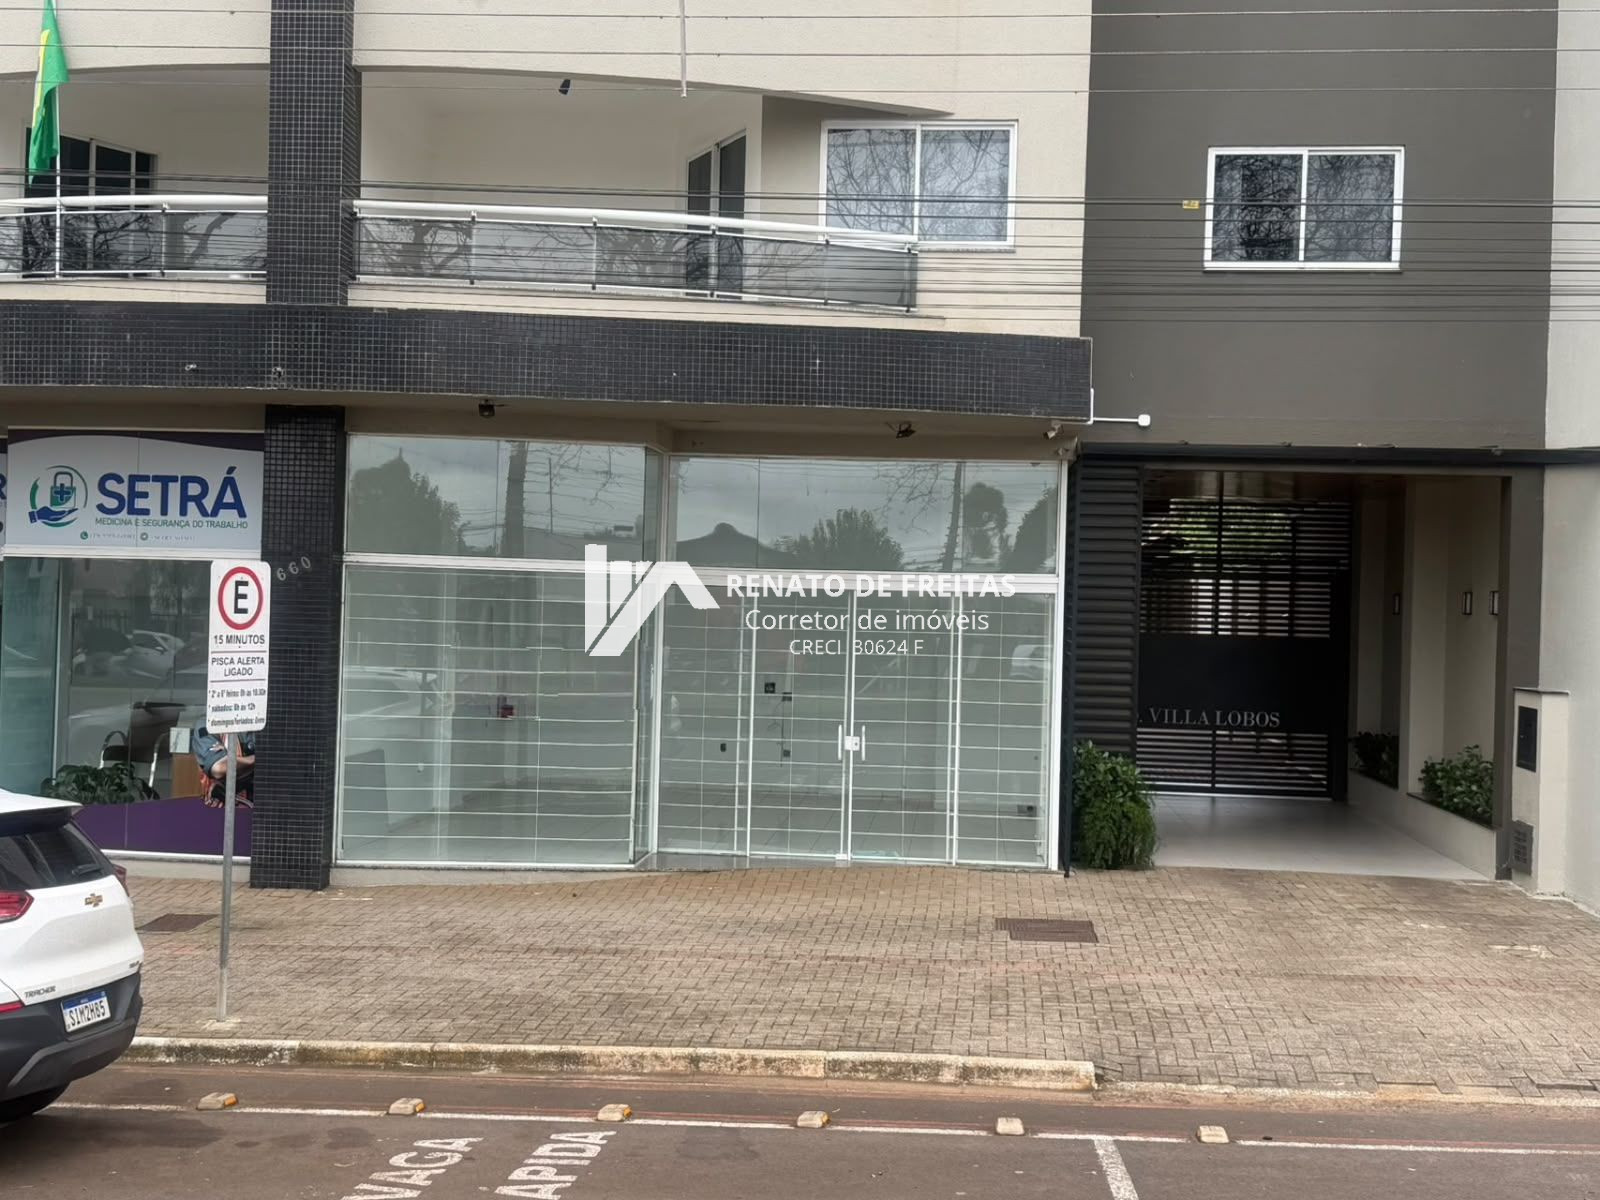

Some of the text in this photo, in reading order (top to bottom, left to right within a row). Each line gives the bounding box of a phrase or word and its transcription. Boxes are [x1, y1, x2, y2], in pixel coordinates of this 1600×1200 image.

[96, 466, 247, 518] SETRÁ
[95, 517, 133, 526] MEDICINA
[142, 518, 190, 529] SEGURANÇA
[193, 520, 203, 528] DO
[205, 520, 248, 529] TRABALHO
[276, 556, 311, 581] 660
[233, 580, 249, 614] E
[213, 634, 266, 645] 15 MINUTOS
[211, 656, 265, 666] PISCA ALERTA
[224, 667, 253, 677] LIGADO
[1149, 708, 1210, 725] VILLA
[1215, 710, 1281, 727] LOBOS
[339, 1137, 485, 1200] VAGA
